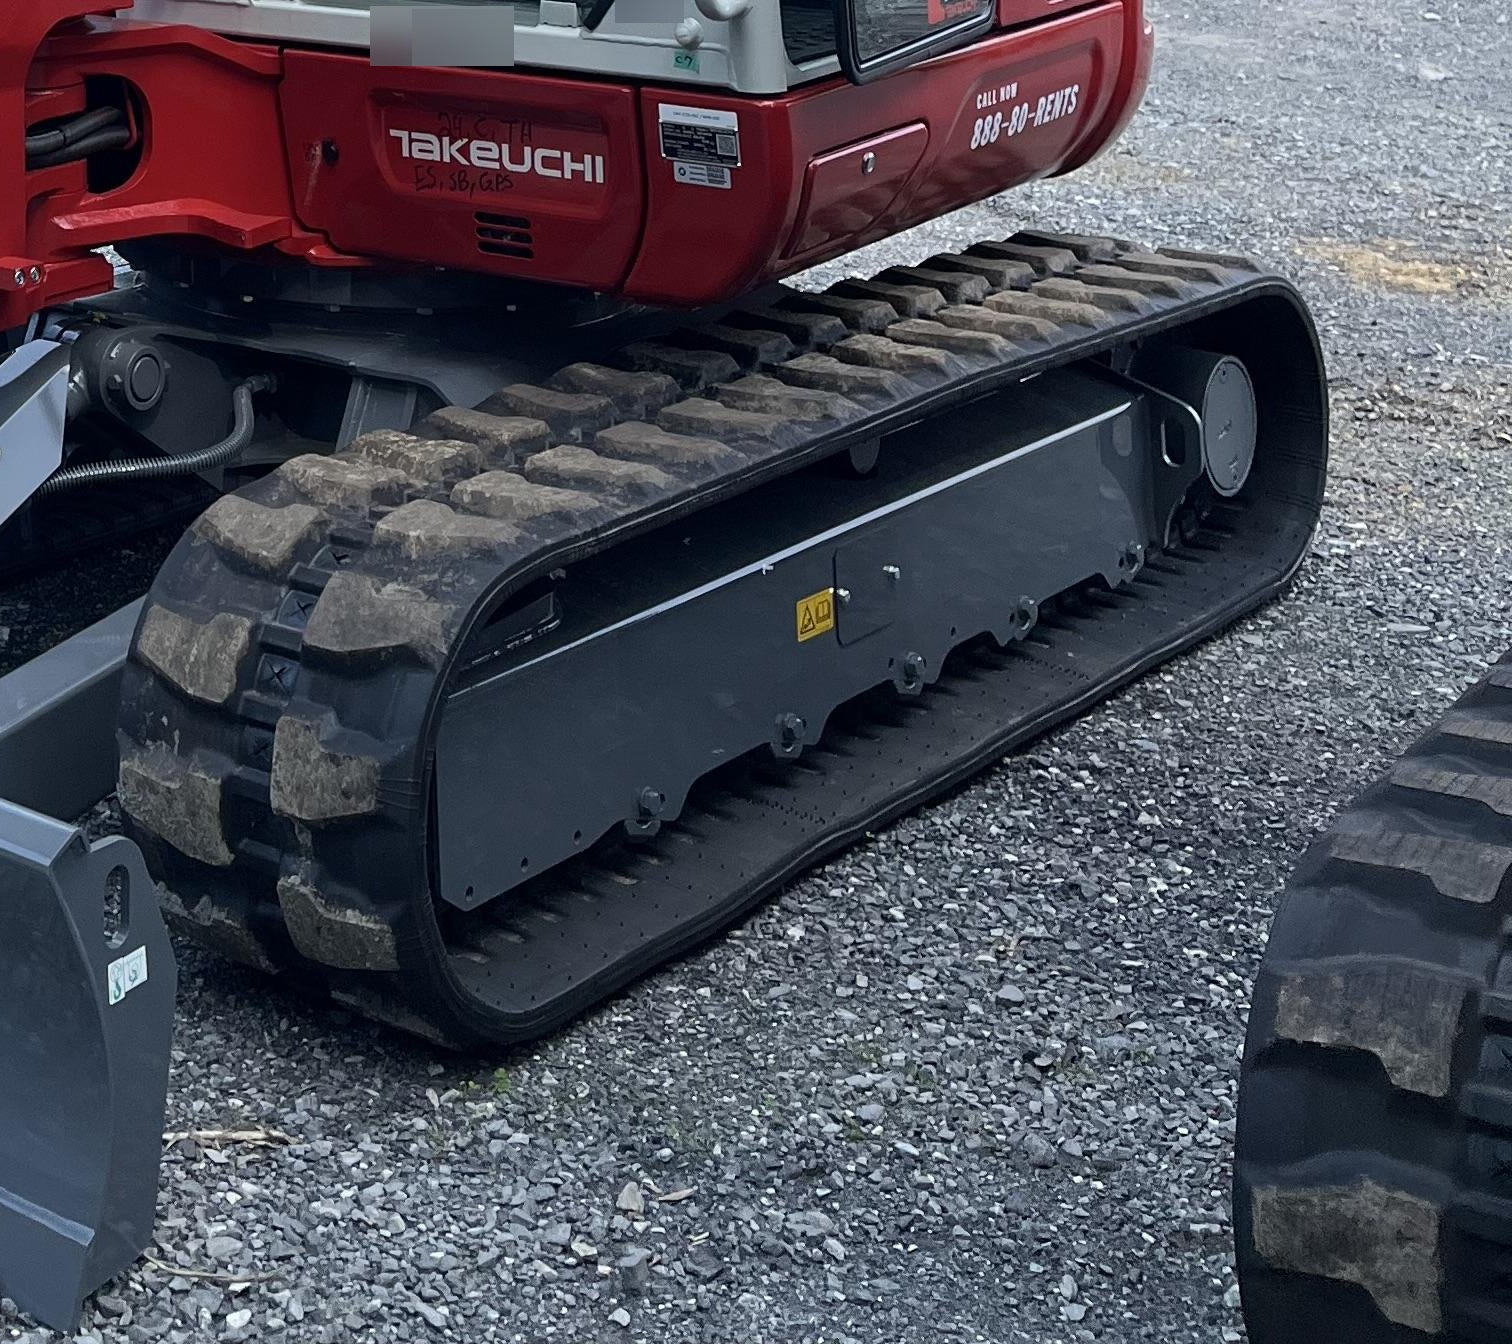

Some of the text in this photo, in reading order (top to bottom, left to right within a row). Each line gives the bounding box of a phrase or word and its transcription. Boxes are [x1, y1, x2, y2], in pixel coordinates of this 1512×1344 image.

[969, 84, 1080, 150] 888-80-RENTS
[976, 82, 1018, 110] CALL NOW
[389, 128, 604, 184] TAKEUCHI
